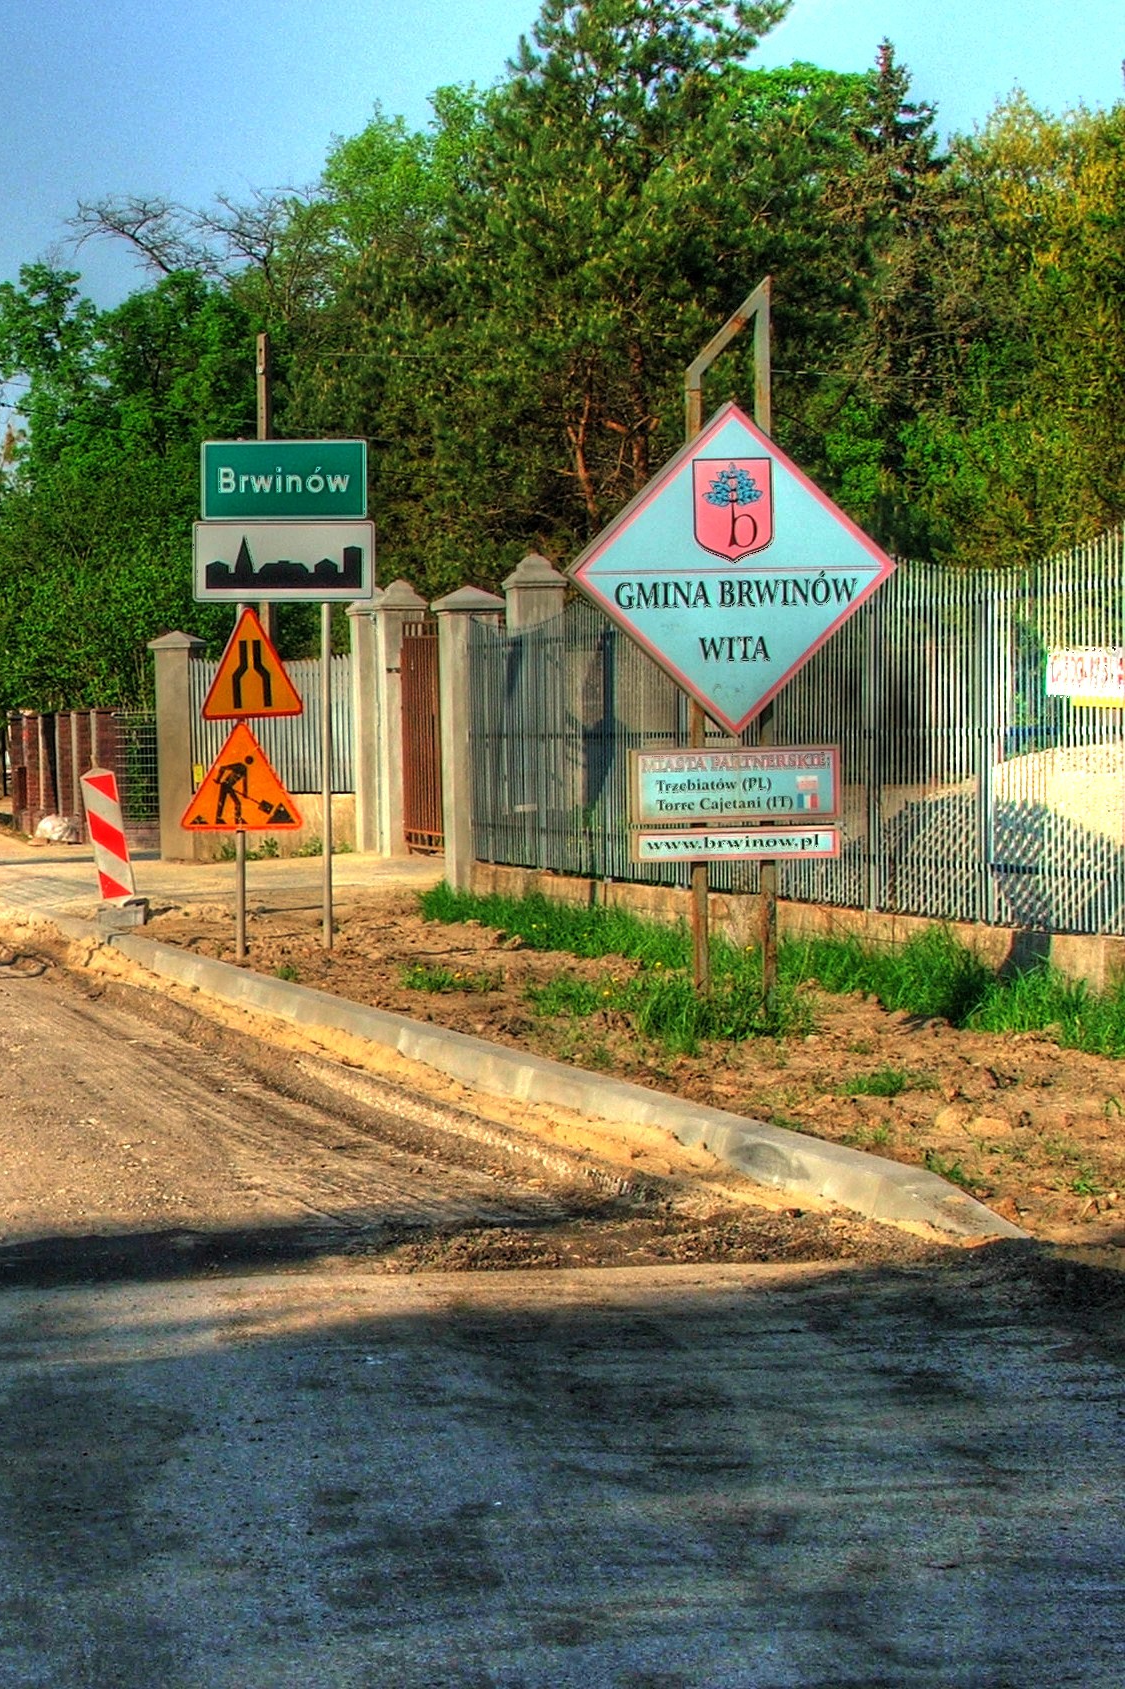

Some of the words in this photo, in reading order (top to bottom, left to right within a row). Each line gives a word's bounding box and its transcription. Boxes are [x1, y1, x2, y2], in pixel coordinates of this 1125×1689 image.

[218, 466, 350, 494] Brwinów
[614, 580, 712, 609] GMINA
[718, 570, 857, 607] BRWINÓW
[699, 635, 771, 662] WITA
[642, 756, 707, 773] MIASTA
[656, 778, 737, 793] Trzebiatów
[742, 776, 772, 793] (PL)
[656, 799, 695, 812] Torre
[699, 797, 762, 813] Cajetani
[766, 795, 794, 811] (IT)
[646, 834, 820, 851] www.brwinow.pl
